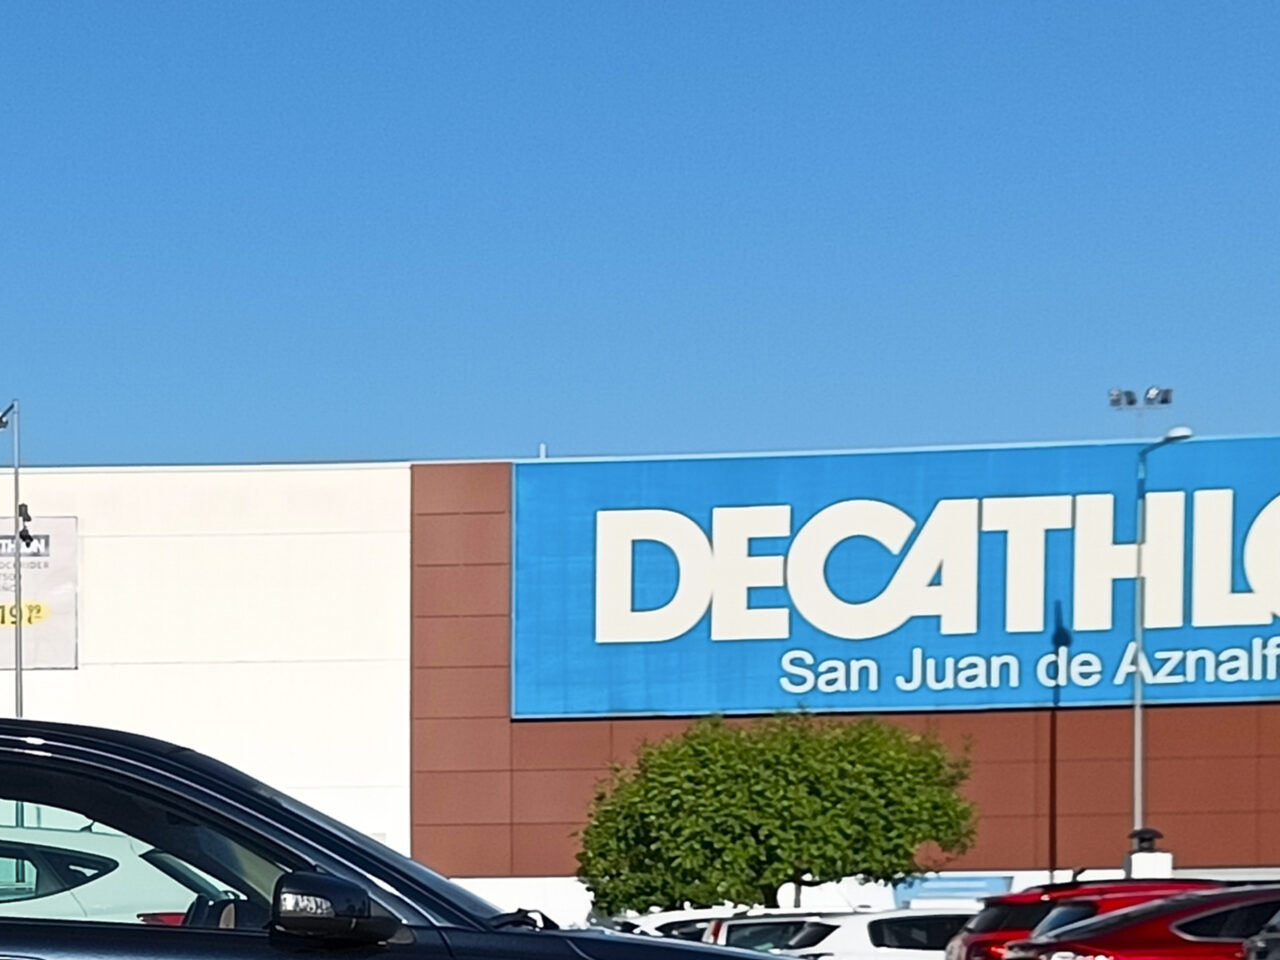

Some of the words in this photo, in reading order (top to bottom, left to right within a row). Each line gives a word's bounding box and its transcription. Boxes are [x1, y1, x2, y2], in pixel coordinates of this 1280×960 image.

[595, 488, 1280, 643] DECATHL
[779, 649, 879, 694] San
[895, 647, 1019, 691] Juan
[1037, 645, 1102, 687] de
